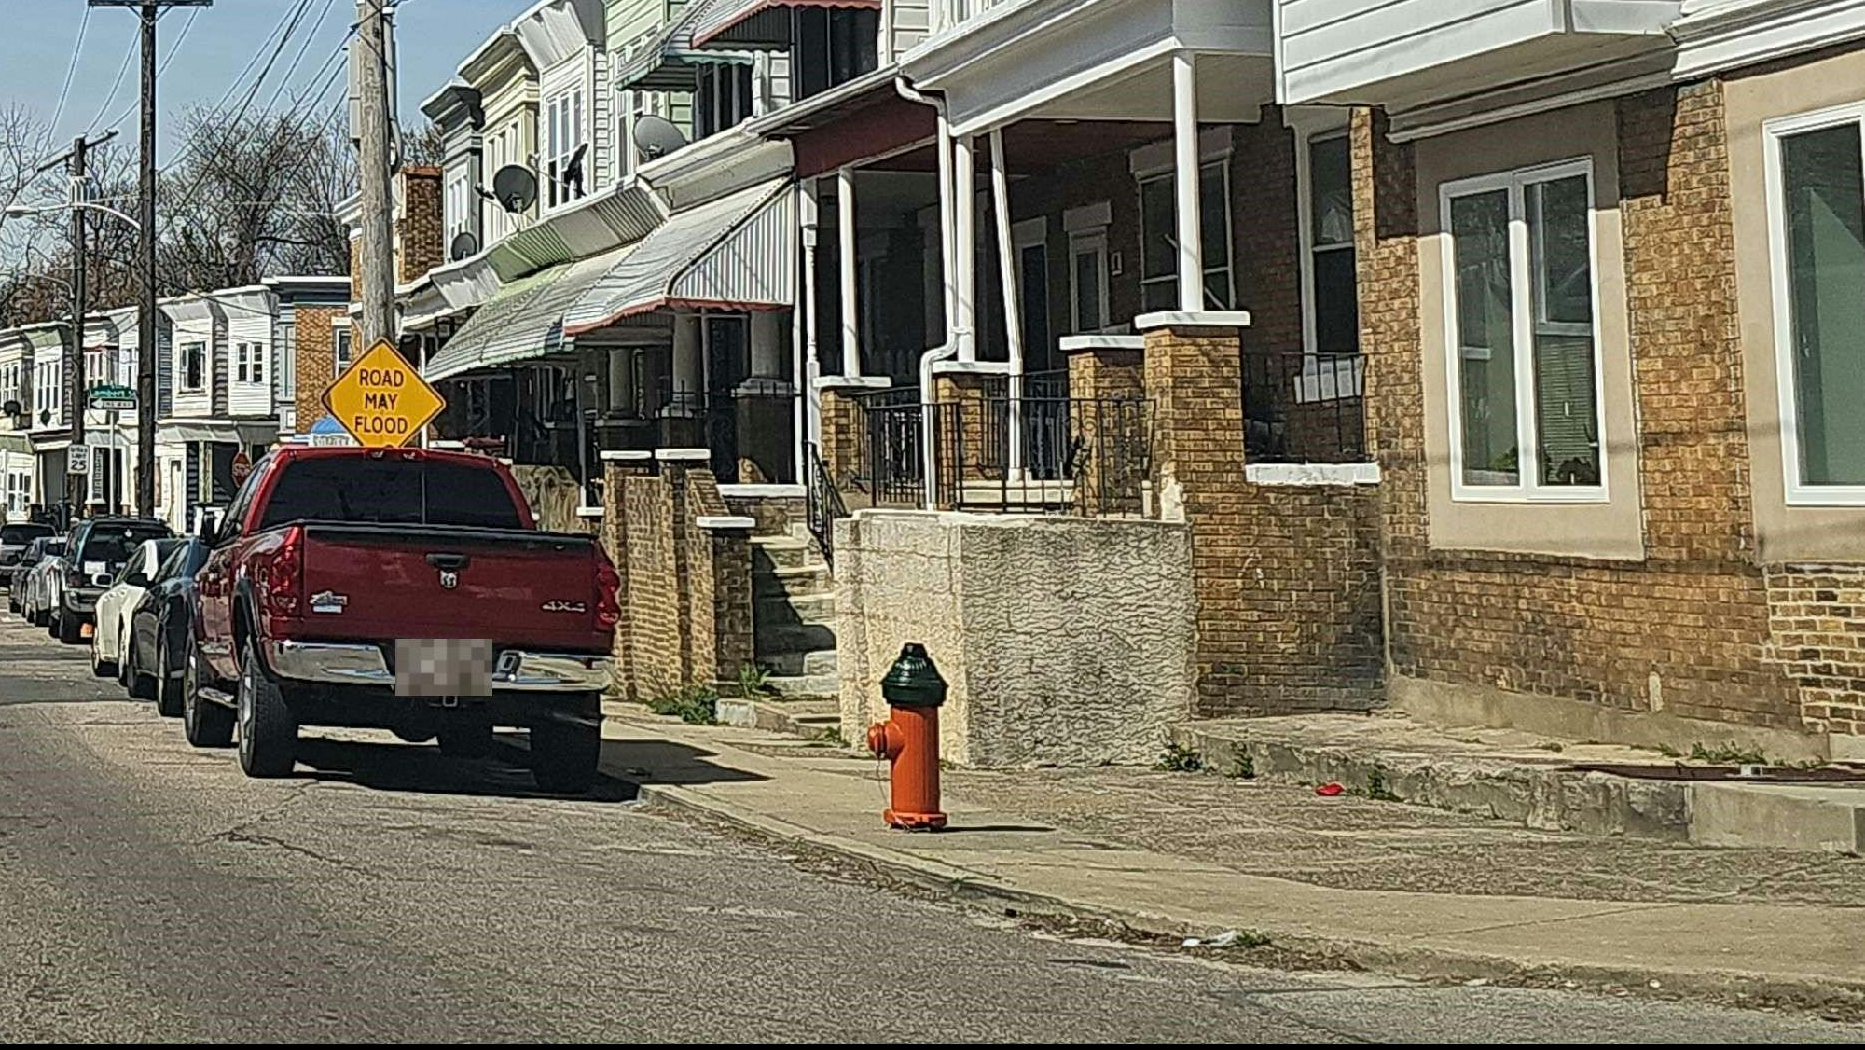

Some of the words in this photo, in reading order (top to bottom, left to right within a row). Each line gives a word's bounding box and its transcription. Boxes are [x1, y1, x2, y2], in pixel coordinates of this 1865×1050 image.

[359, 369, 404, 387] ROAD
[365, 393, 397, 410] MAY
[355, 416, 408, 433] FLOOD
[71, 460, 87, 471] 25
